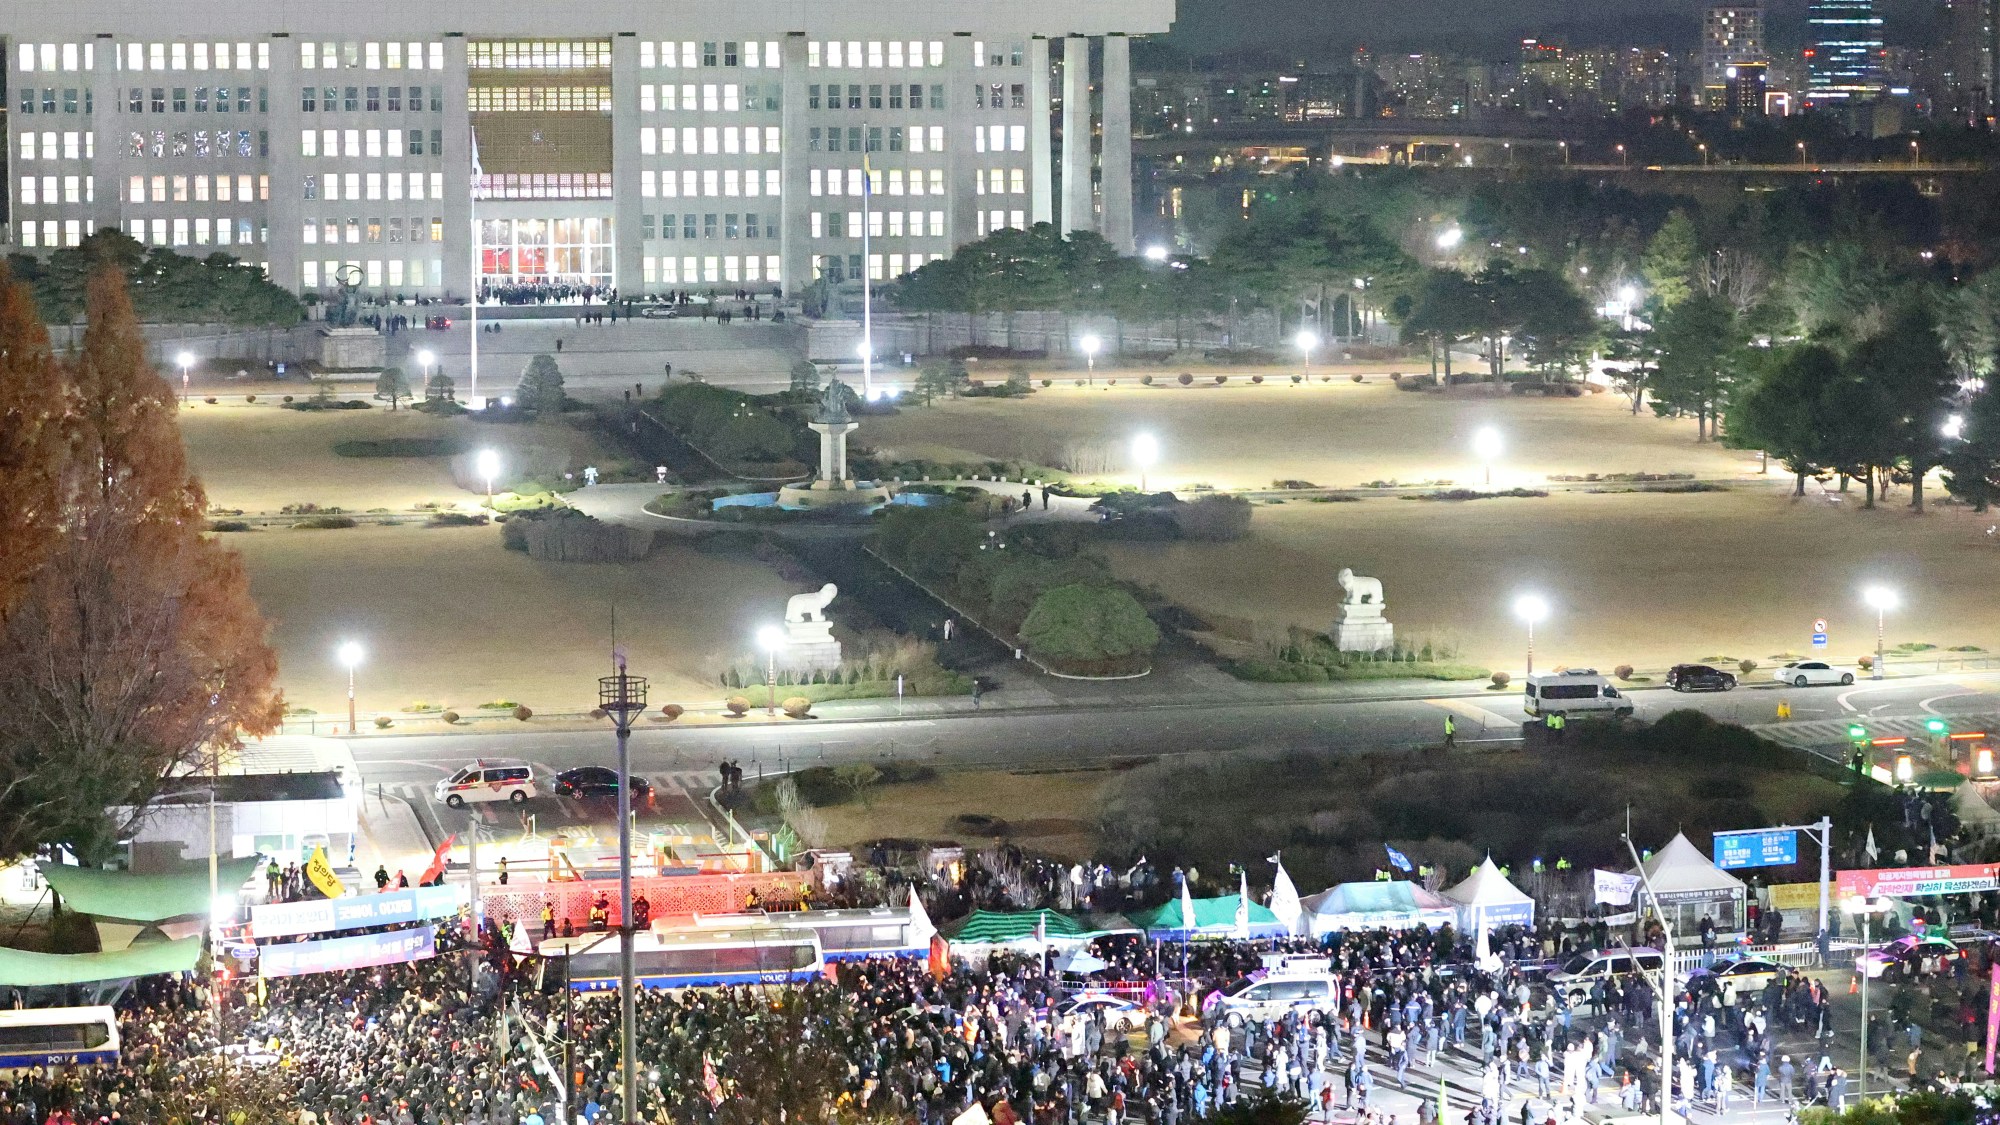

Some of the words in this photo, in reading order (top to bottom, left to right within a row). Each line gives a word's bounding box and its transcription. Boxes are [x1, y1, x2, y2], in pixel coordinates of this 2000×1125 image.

[313, 858, 336, 887] 정의당
[1878, 883, 1914, 894] 과학인재
[1915, 881, 1942, 892] 확실히
[1944, 879, 1997, 891] 육성하겠습니
[258, 912, 292, 926] 우리가
[48, 1055, 78, 1063] POLIE
